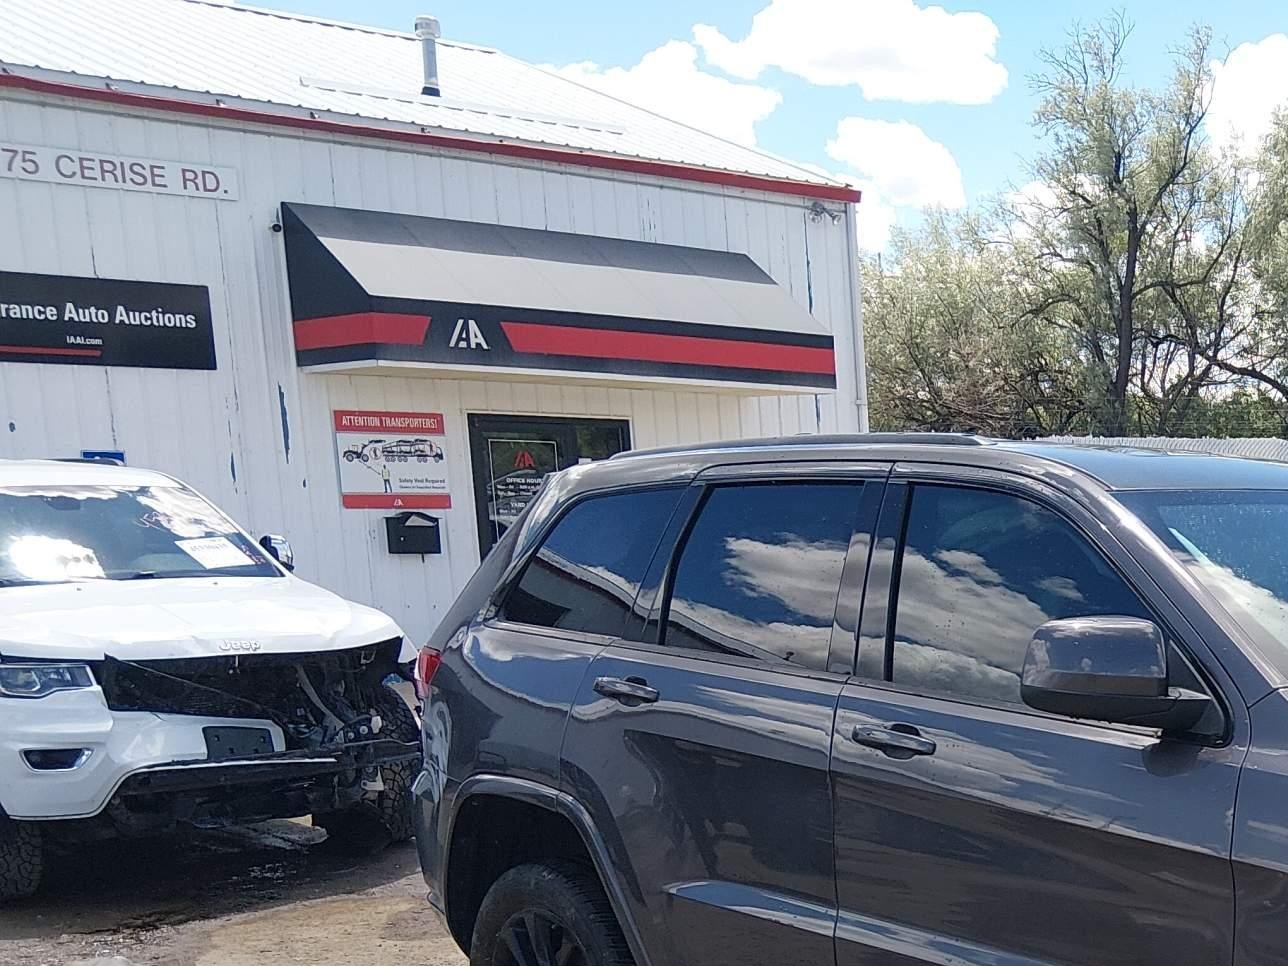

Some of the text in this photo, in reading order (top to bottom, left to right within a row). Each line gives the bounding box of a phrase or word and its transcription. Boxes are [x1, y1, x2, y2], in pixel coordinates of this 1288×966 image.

[55, 155, 168, 188] CERISE
[181, 168, 228, 194] RD.
[64, 303, 109, 324] Auto
[115, 305, 197, 328] Auctions
[342, 415, 438, 429] ATTENTION TRANSPORTERS!
[218, 639, 261, 651] Jeep
